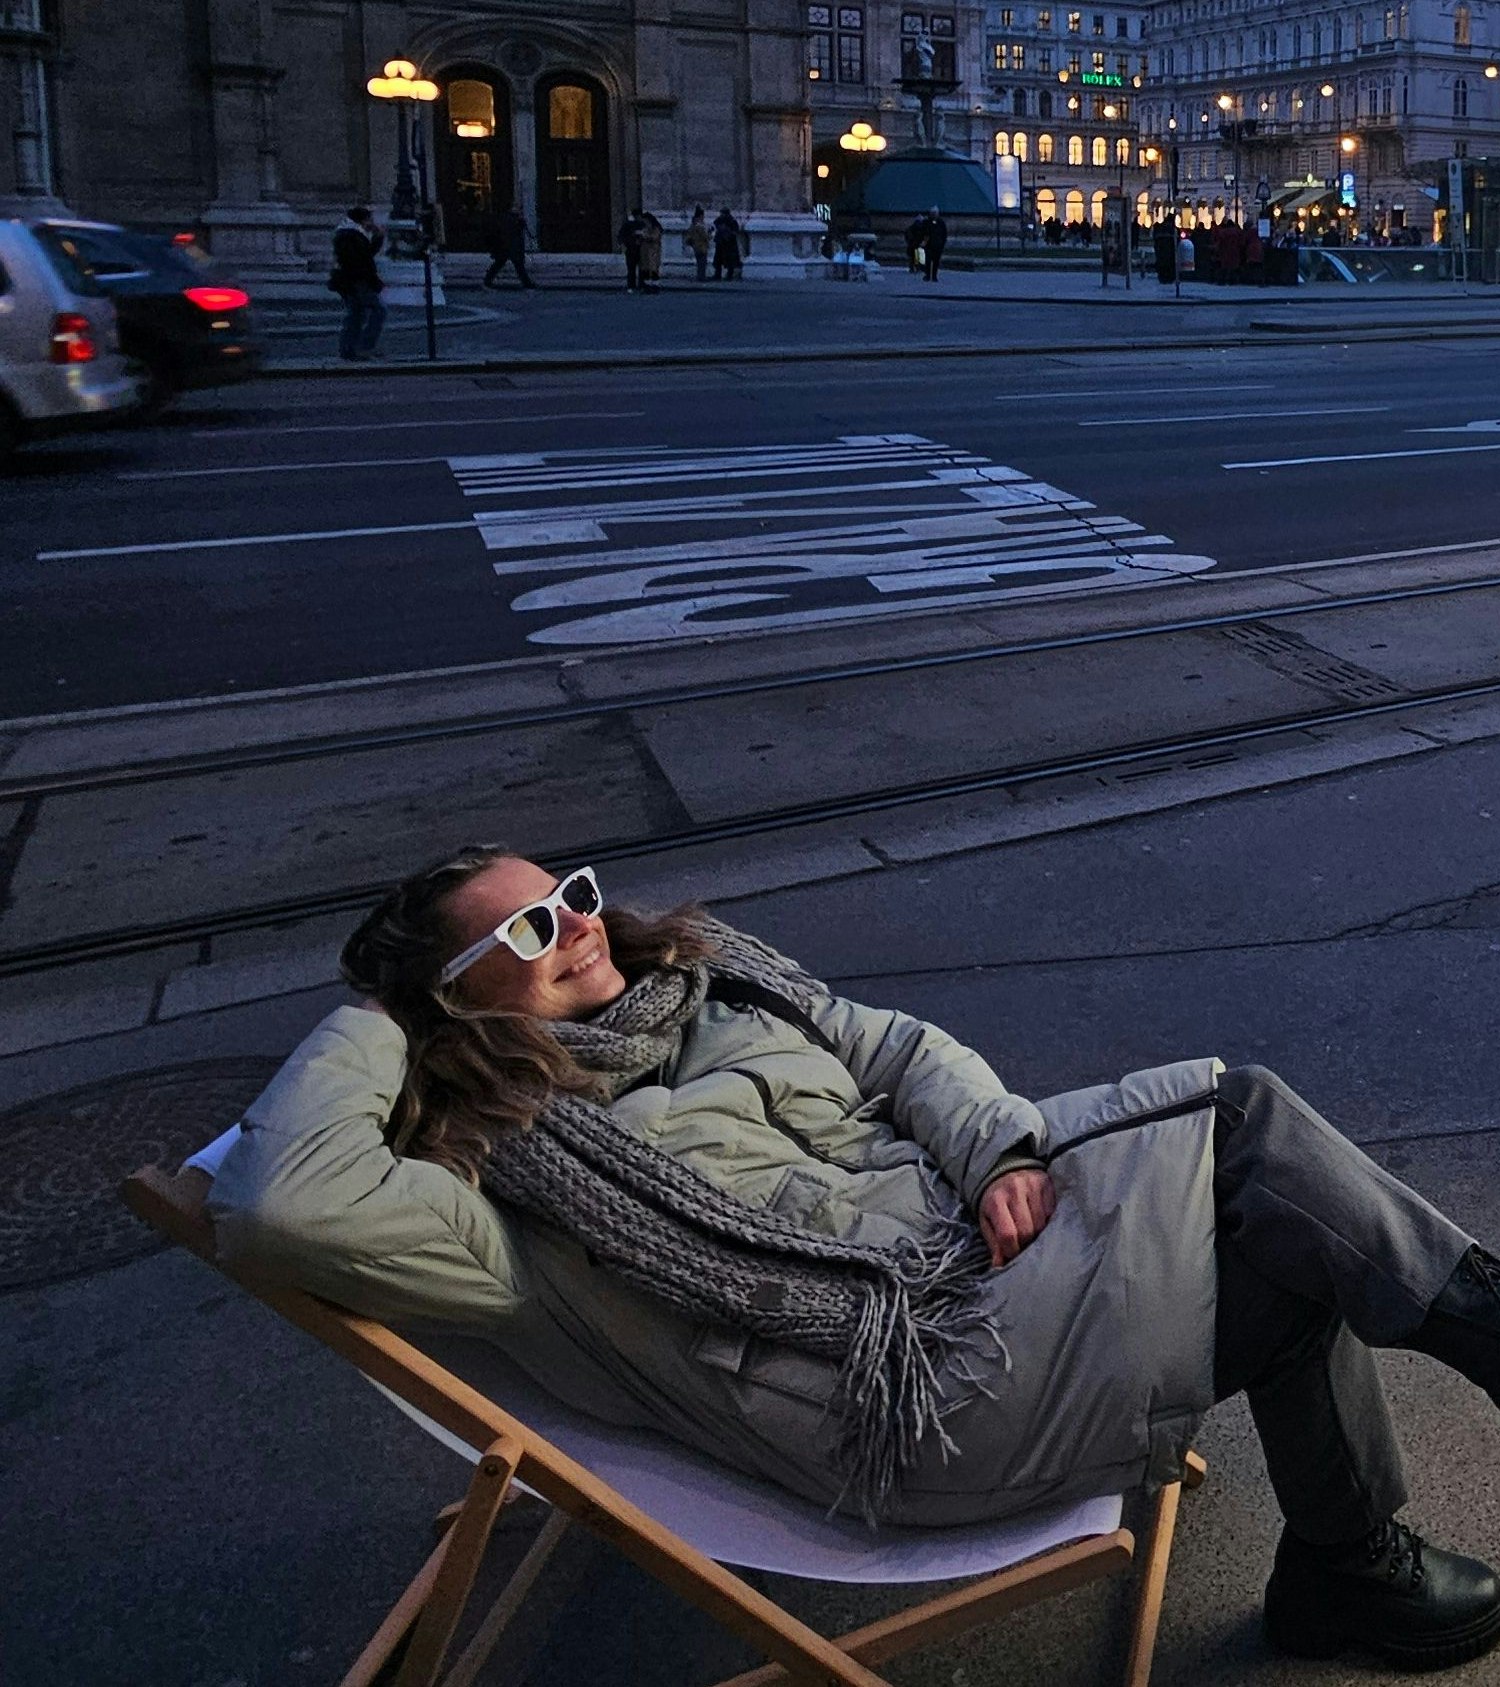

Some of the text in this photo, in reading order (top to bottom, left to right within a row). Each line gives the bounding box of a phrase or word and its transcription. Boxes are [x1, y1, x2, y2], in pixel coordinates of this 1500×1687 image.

[1082, 73, 1122, 87] ROLEX
[446, 433, 1218, 645] GRAZ LINZ
